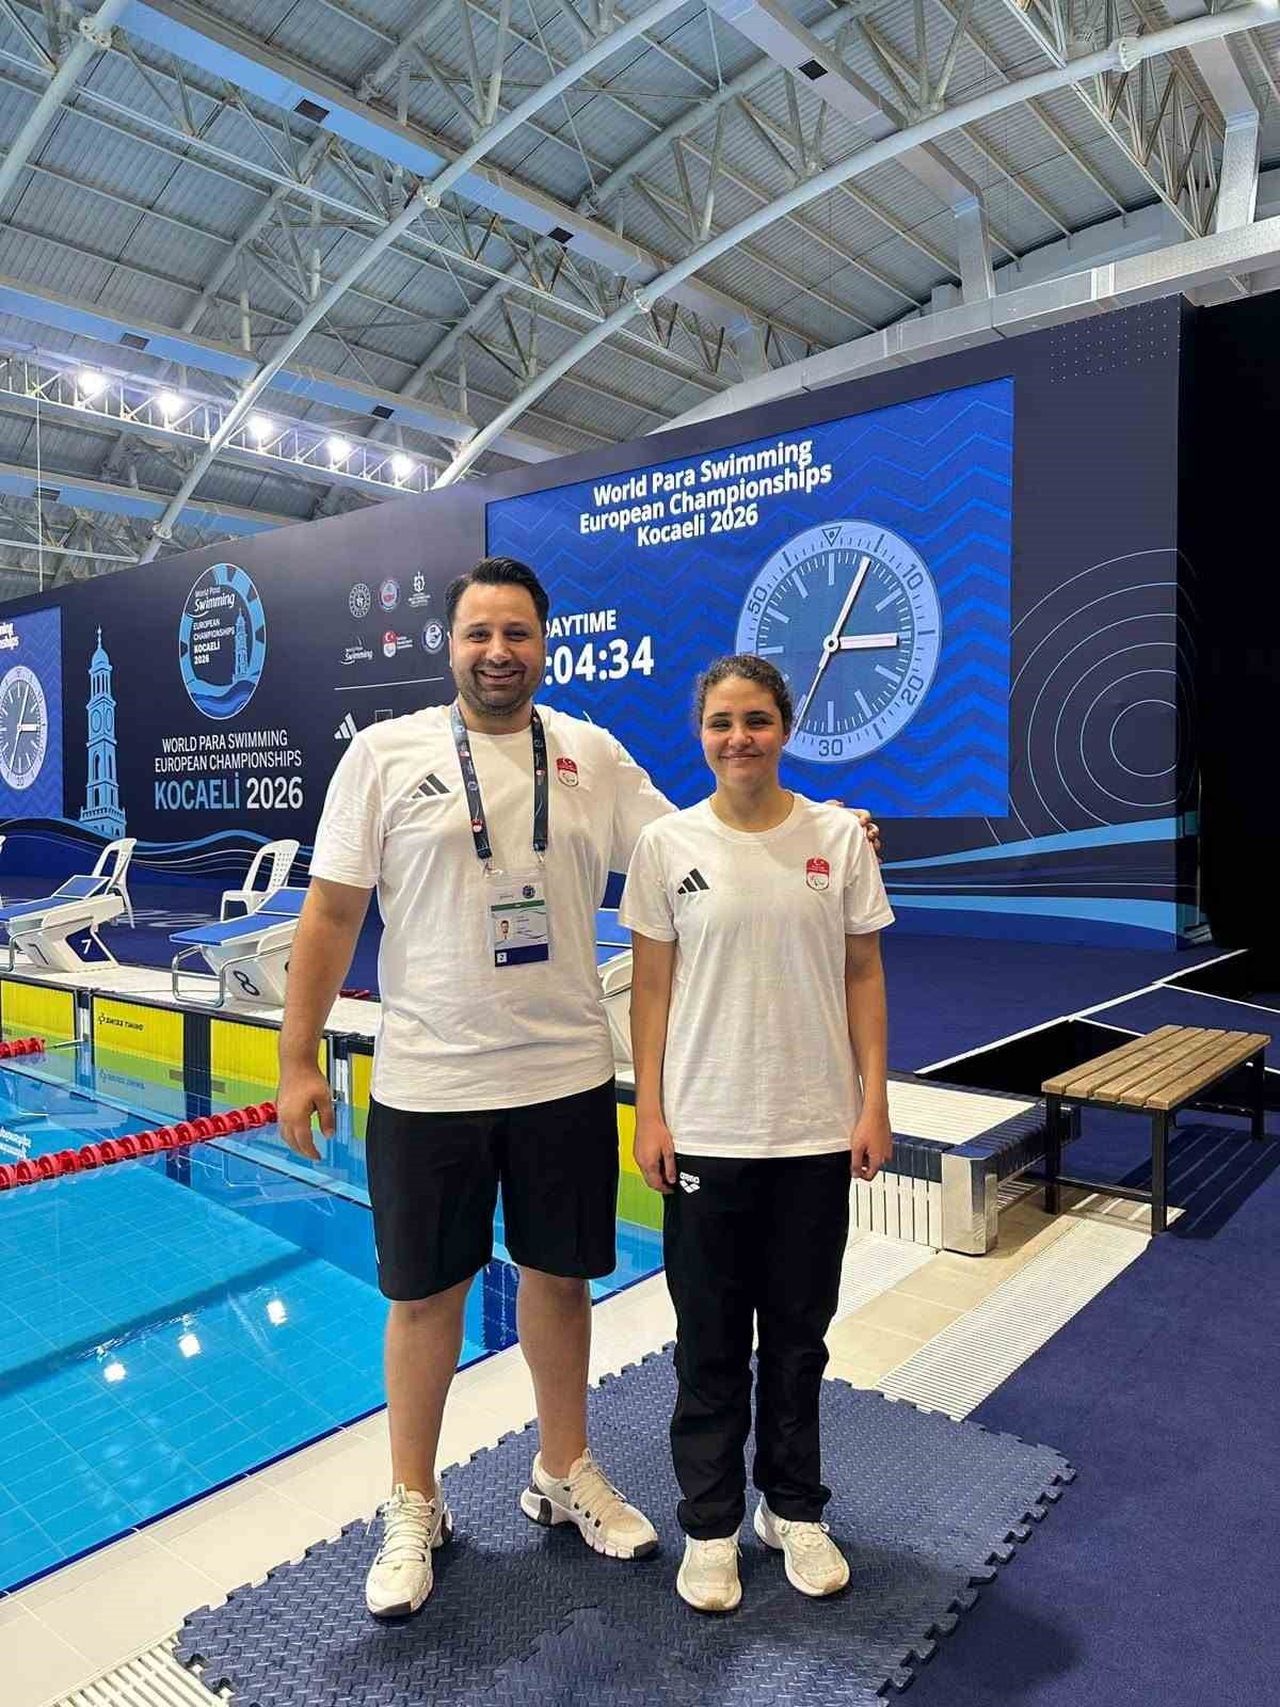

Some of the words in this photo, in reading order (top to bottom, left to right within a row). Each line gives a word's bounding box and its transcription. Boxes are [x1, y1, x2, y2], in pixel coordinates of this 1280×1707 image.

[594, 475, 647, 506] World
[652, 468, 696, 493] Para
[700, 440, 813, 483] Swimming
[580, 501, 664, 533] European
[670, 464, 832, 514] Championships
[638, 513, 705, 546] Kocaeli
[710, 503, 758, 533] 2026
[902, 564, 925, 590] 10
[194, 592, 235, 611] Swimming
[747, 585, 767, 614] 50
[193, 618, 221, 631] EUROPEAN
[193, 626, 235, 641] CHAMPIONSHIPS
[901, 675, 924, 706] 20
[162, 736, 197, 753] WORLD
[200, 734, 226, 751] PARA
[228, 729, 288, 749] SWIMMING
[818, 739, 843, 757] 30
[155, 755, 207, 773] EUROPEAN
[209, 750, 302, 771] CHAMPIONSHIPS
[154, 771, 240, 810] KOCAELİ
[246, 776, 303, 810] 2026
[81, 938, 92, 955] 7
[233, 970, 260, 996] 8
